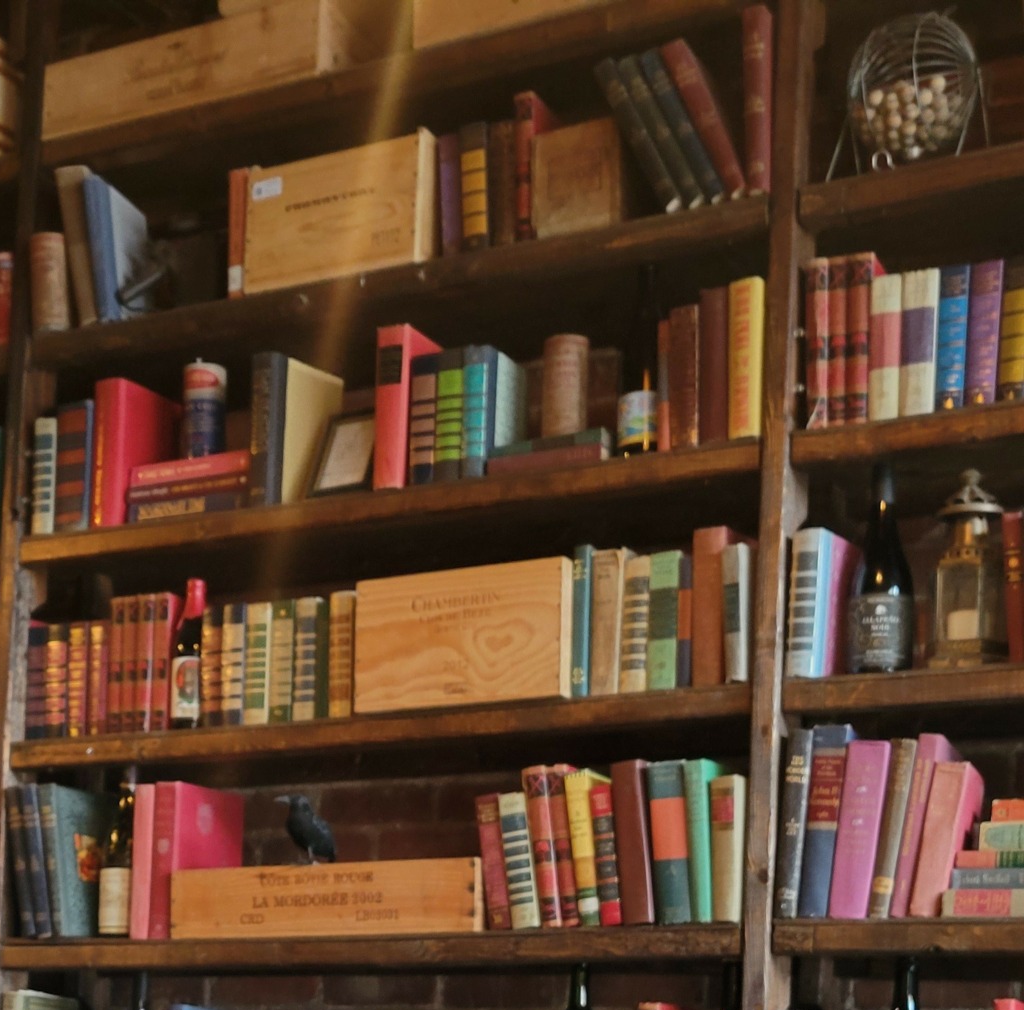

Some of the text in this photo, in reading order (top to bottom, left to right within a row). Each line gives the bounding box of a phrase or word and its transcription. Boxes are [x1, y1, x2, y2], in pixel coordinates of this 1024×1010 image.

[411, 591, 500, 613] CHAMBERTIN
[252, 895, 269, 909] LA
[273, 890, 349, 909] MORDORÉE
